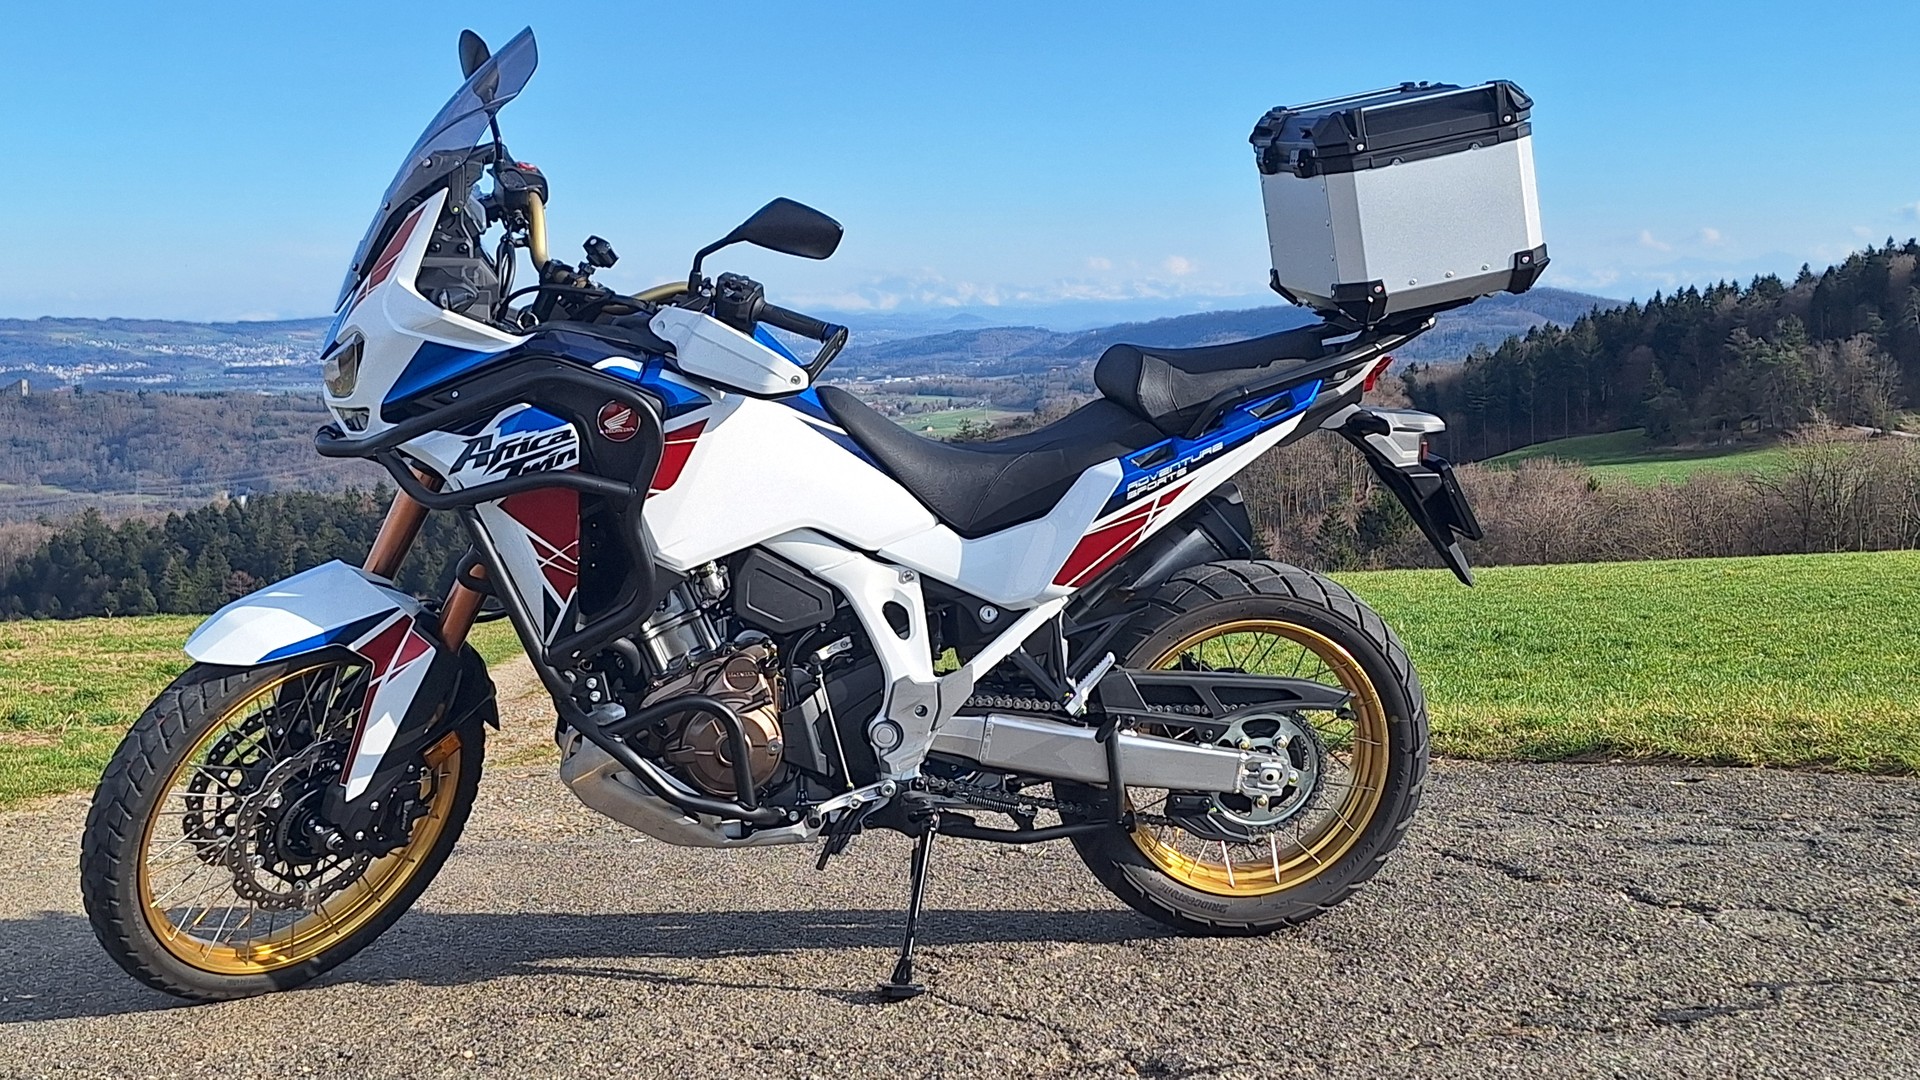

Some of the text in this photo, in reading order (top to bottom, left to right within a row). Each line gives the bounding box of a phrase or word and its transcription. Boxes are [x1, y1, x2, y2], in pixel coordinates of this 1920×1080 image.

[448, 429, 576, 476] Africa
[487, 440, 578, 477] Twin
[1127, 441, 1224, 492] ADVENTURE
[1127, 466, 1188, 500] SPORTS
